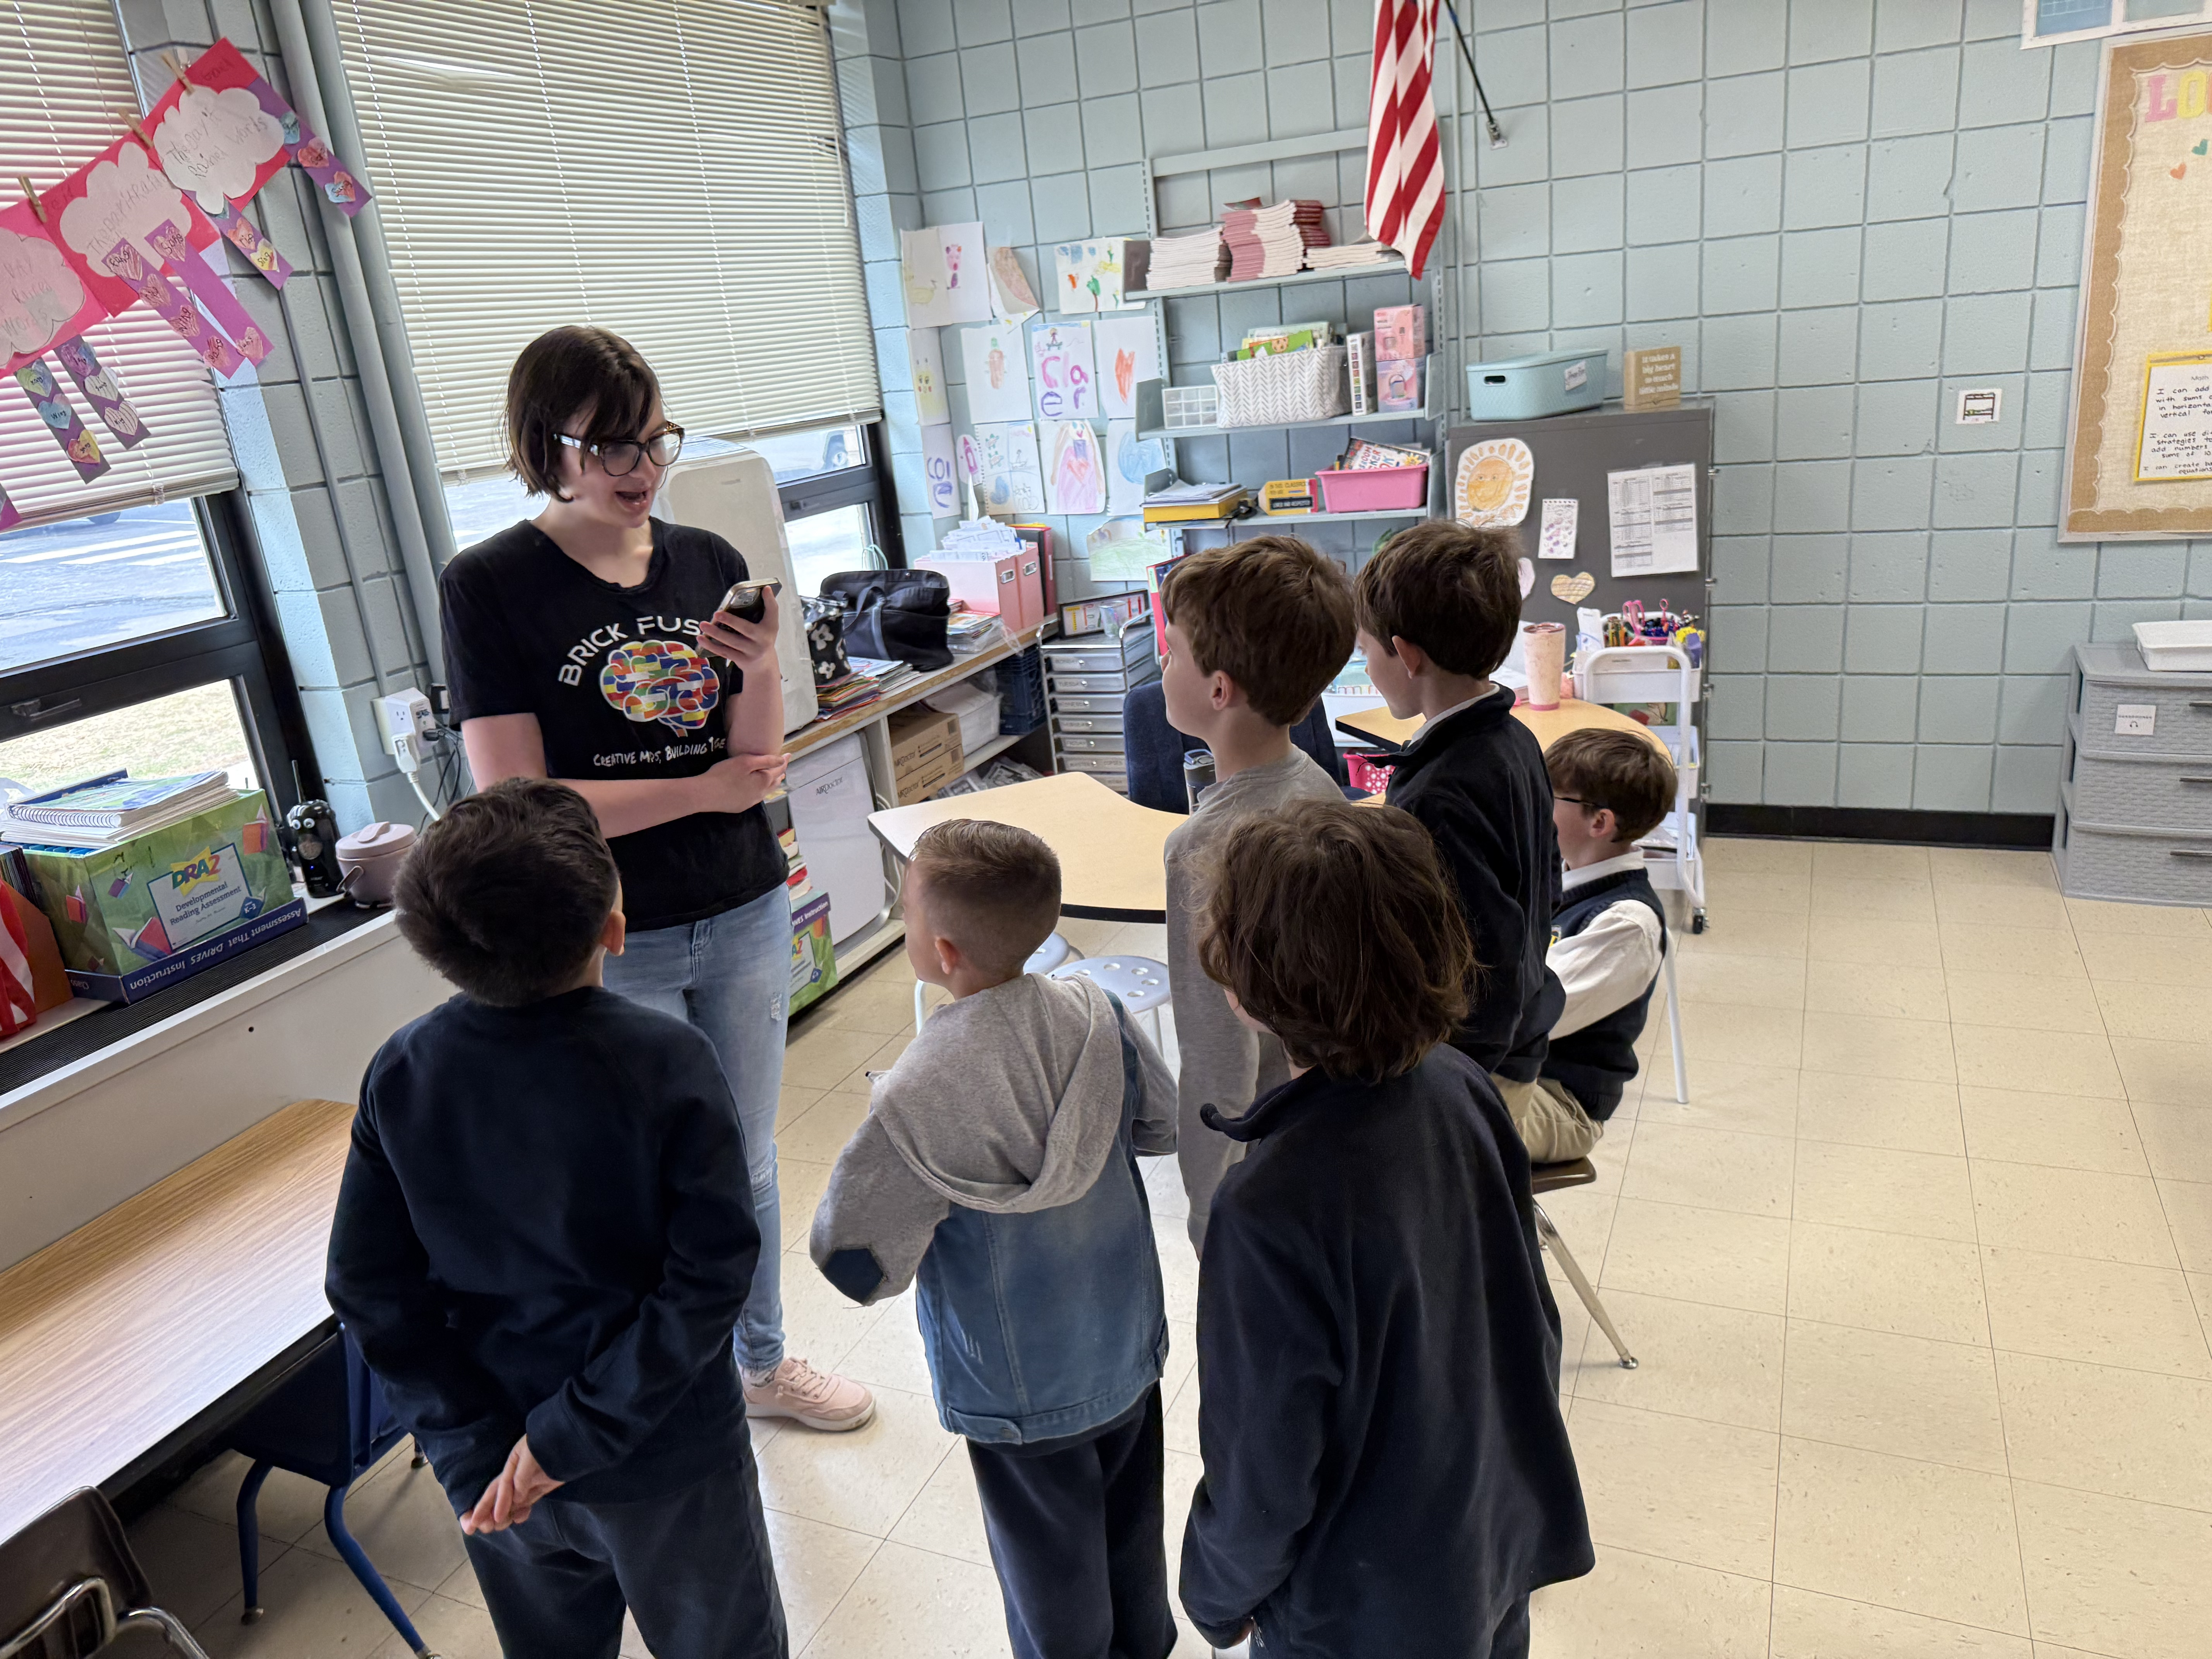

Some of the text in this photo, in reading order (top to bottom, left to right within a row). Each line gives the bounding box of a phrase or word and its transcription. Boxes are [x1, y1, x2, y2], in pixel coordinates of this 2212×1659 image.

[2145, 70, 2212, 122] LO
[2160, 410, 2190, 418] vertical
[2157, 437, 2196, 446] strategies
[558, 616, 701, 686] BRICK FUS
[593, 751, 636, 767] CREATIVE
[665, 743, 707, 761] BUILDING
[170, 907, 200, 925] Reading
[200, 885, 242, 911] Assessment
[175, 881, 229, 912] Developmental
[252, 907, 302, 934] Assessment
[804, 901, 829, 920] Instruction
[228, 933, 251, 948] That
[191, 943, 223, 965] DRIVES
[130, 960, 186, 990] Instruction
